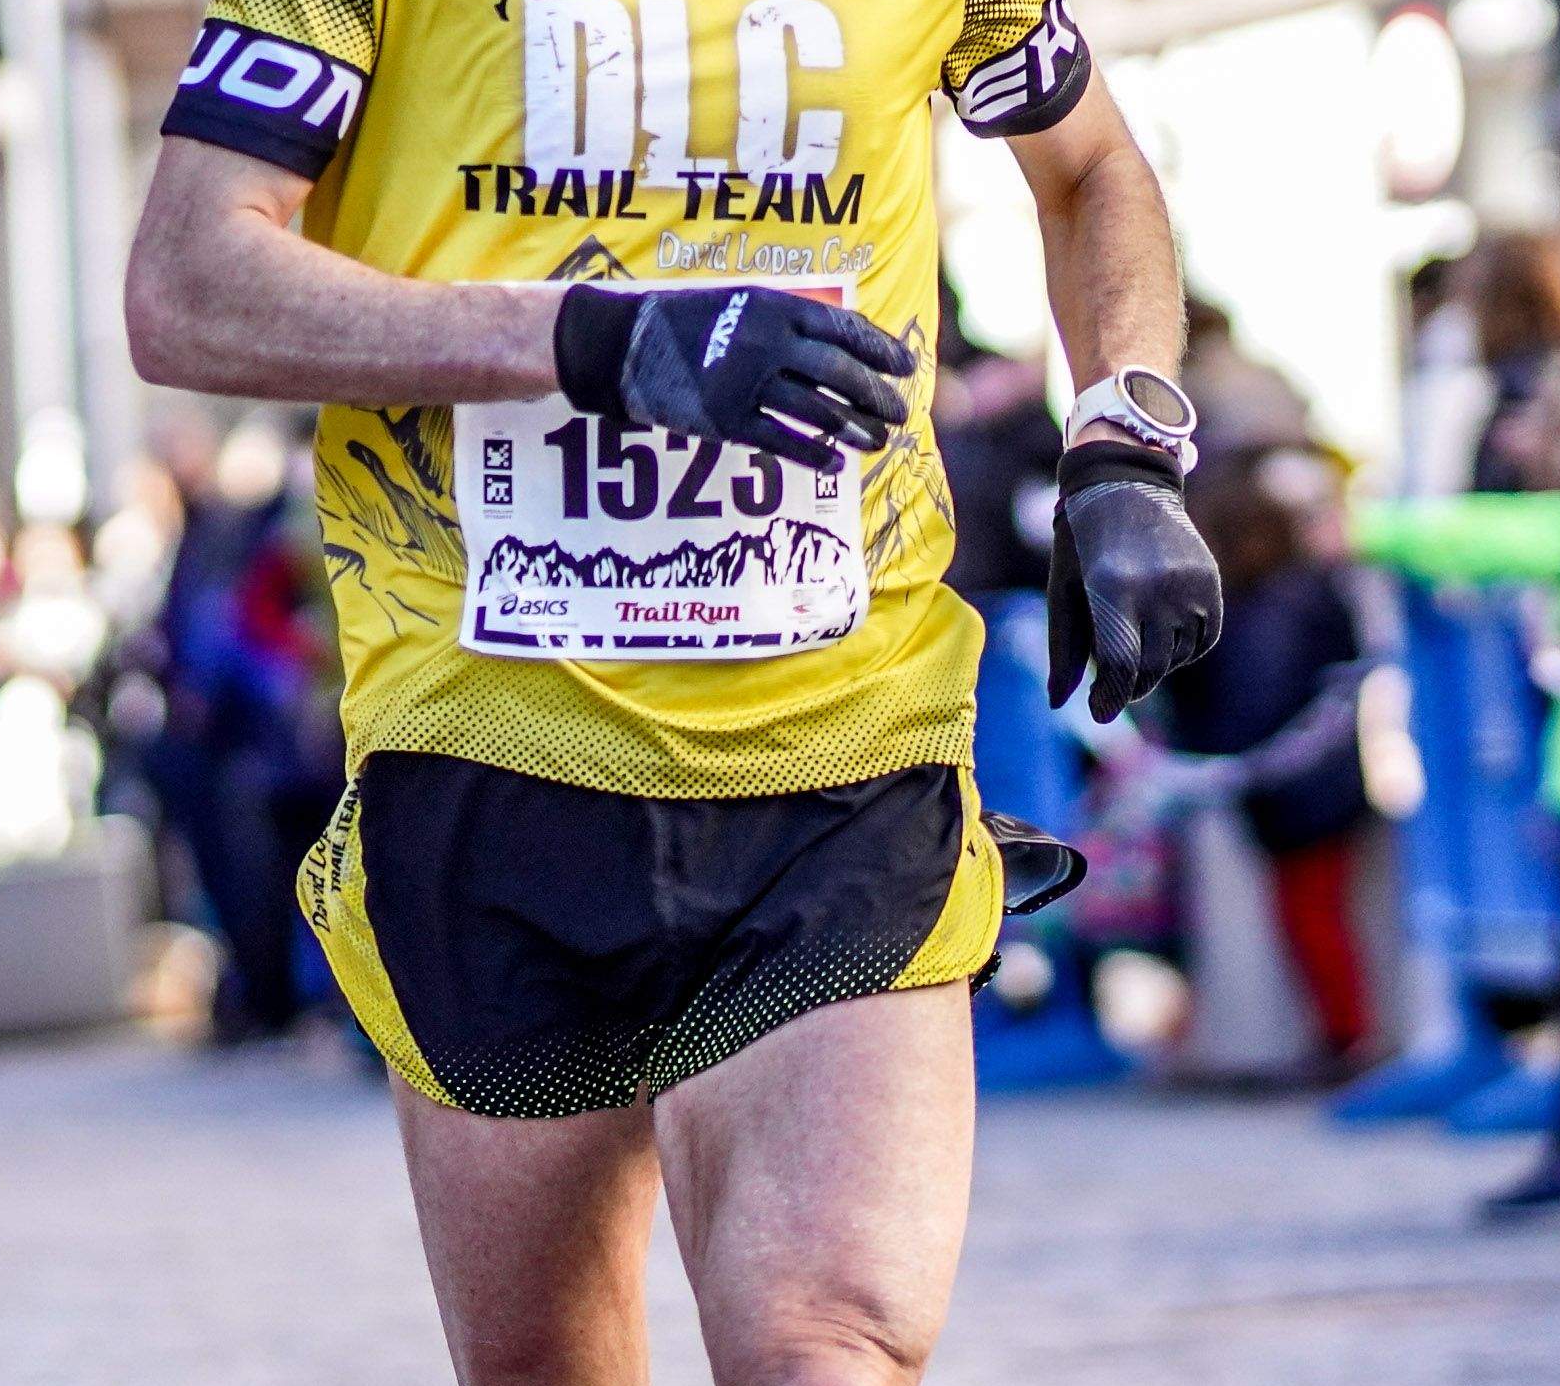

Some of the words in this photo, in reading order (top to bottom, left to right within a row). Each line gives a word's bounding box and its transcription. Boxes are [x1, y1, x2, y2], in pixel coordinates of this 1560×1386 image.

[457, 163, 647, 220] TRAIL
[677, 169, 866, 226] TEAM
[657, 229, 732, 271] David
[736, 232, 814, 275] Lopez
[544, 417, 784, 521] 1523
[518, 599, 570, 616] asics
[614, 601, 682, 622] Trail
[683, 601, 740, 625] Run
[331, 841, 346, 893] TRAIL
